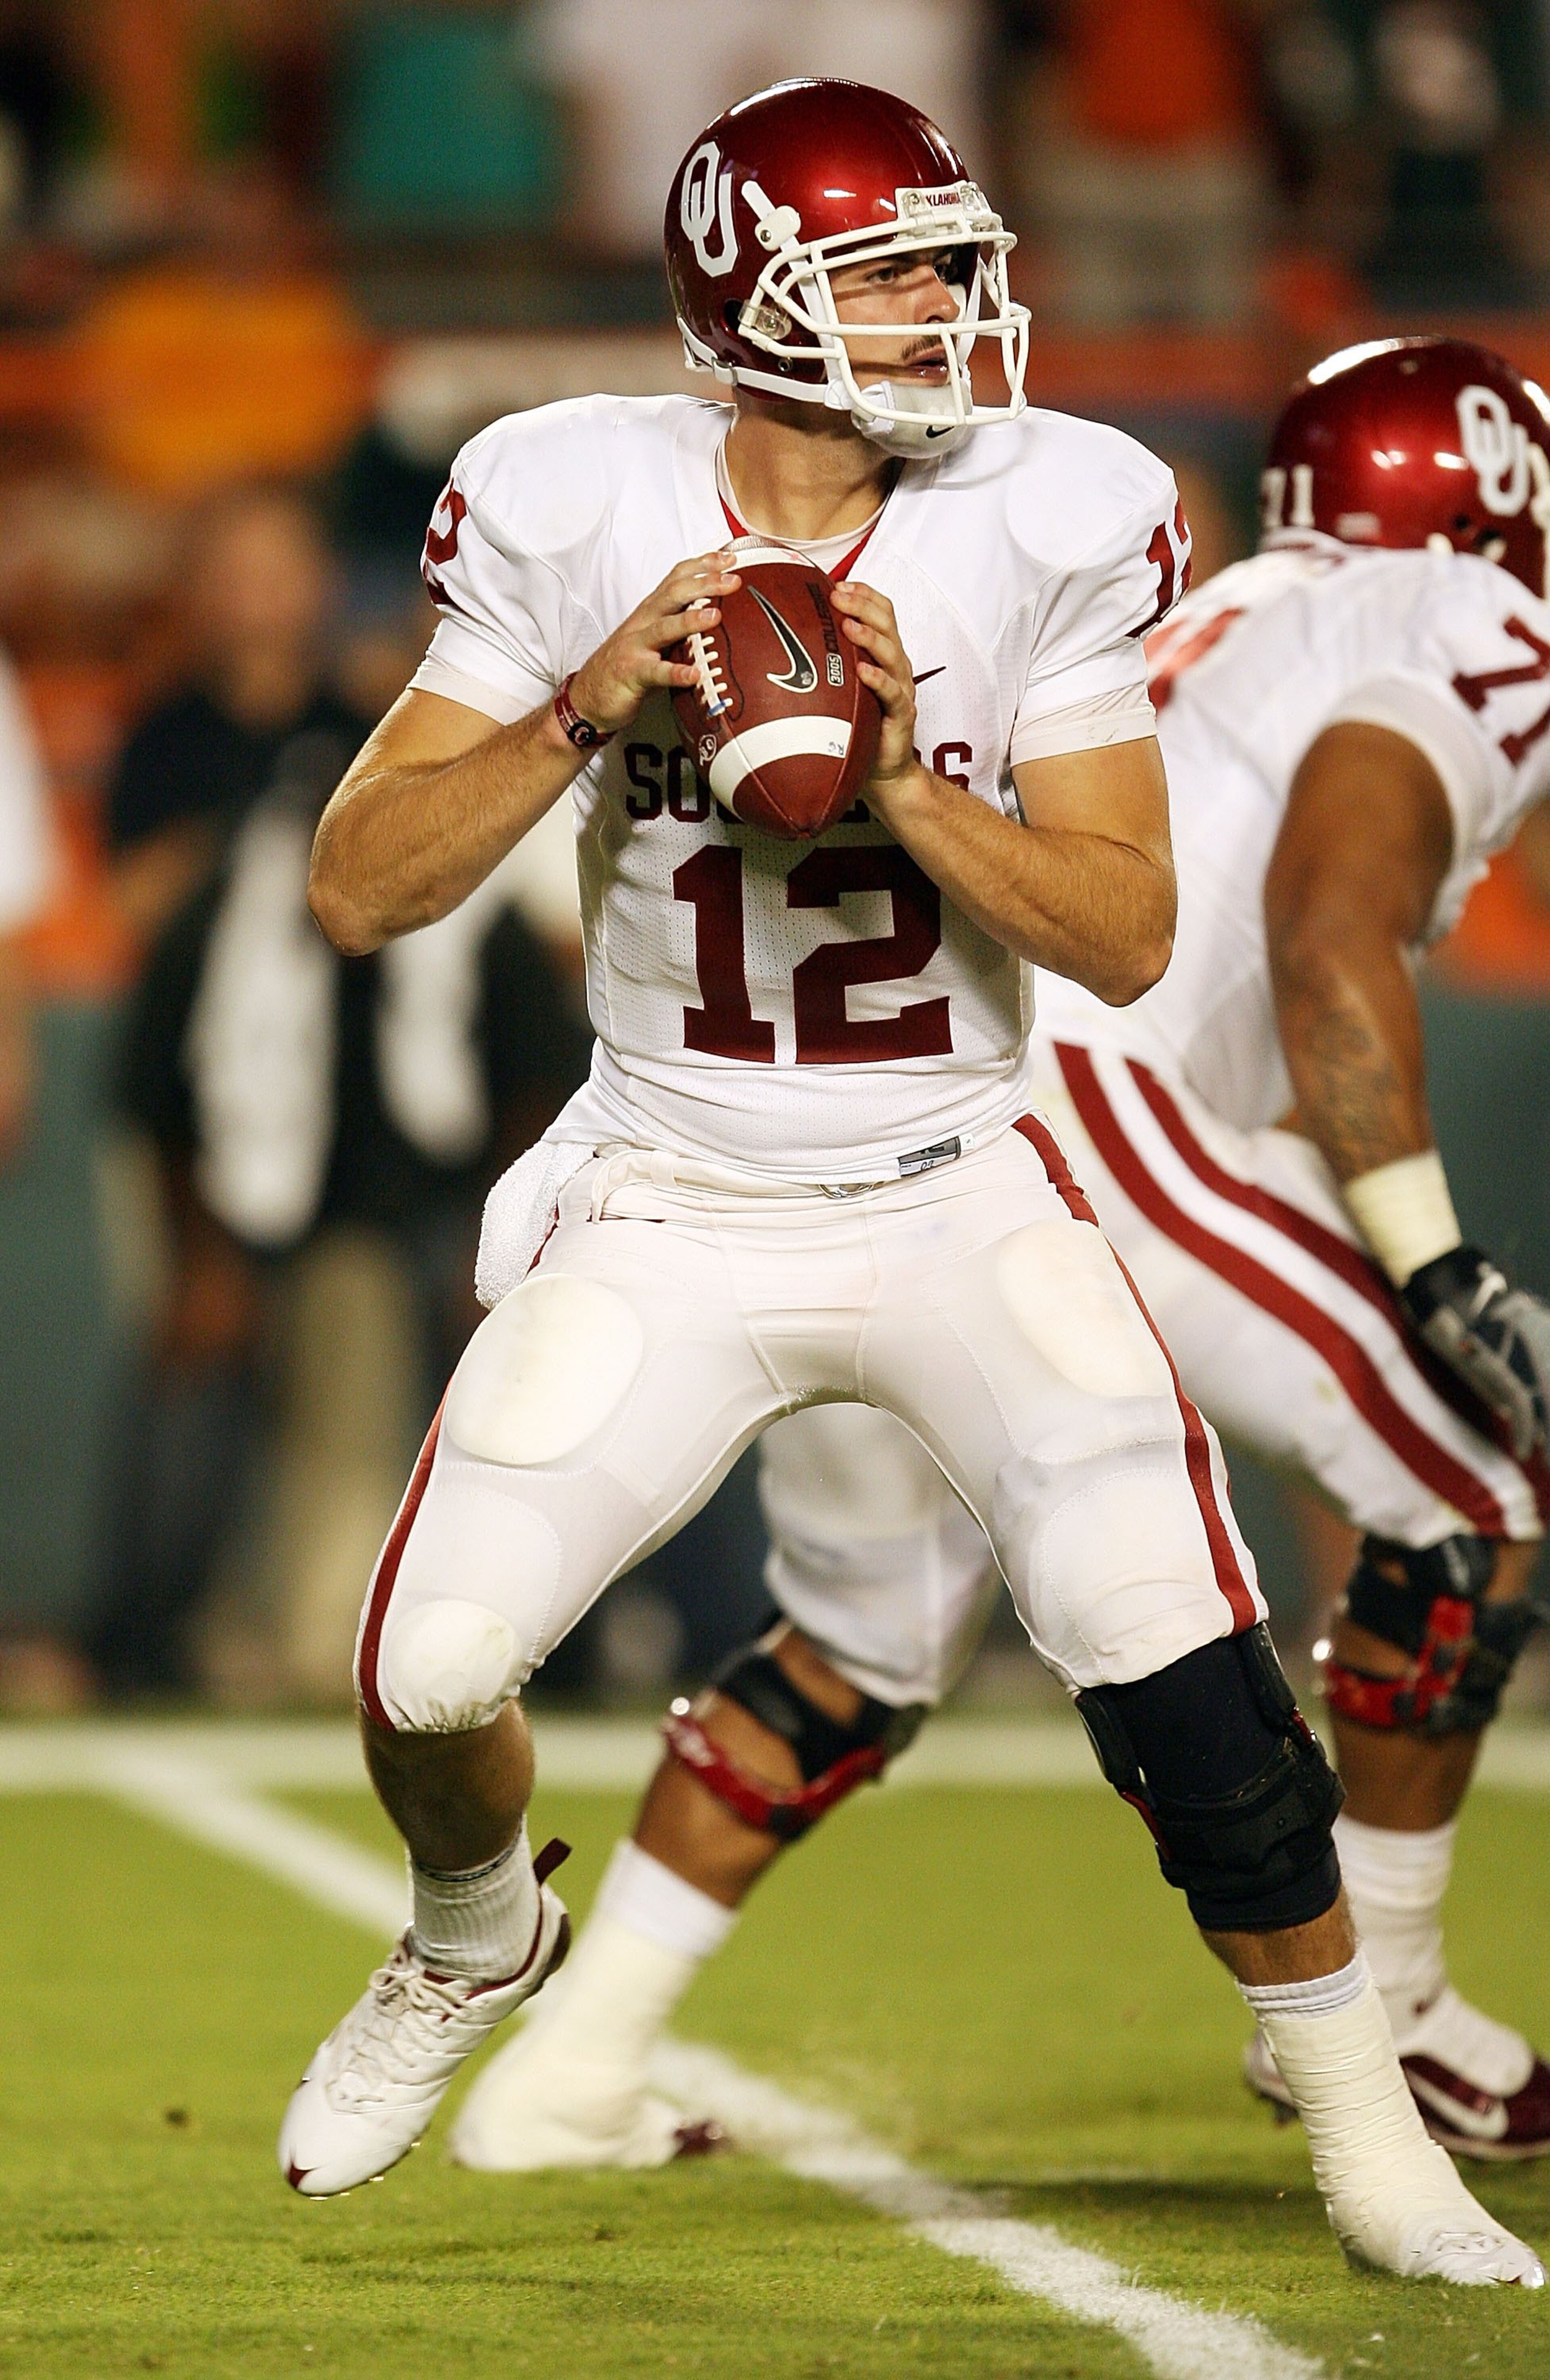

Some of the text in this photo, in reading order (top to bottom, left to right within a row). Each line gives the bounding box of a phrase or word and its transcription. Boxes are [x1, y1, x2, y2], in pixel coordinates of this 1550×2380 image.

[681, 141, 738, 277] OU
[922, 191, 962, 207] KLAHOMA
[1456, 383, 1532, 517] OU
[672, 844, 954, 1064] 12
